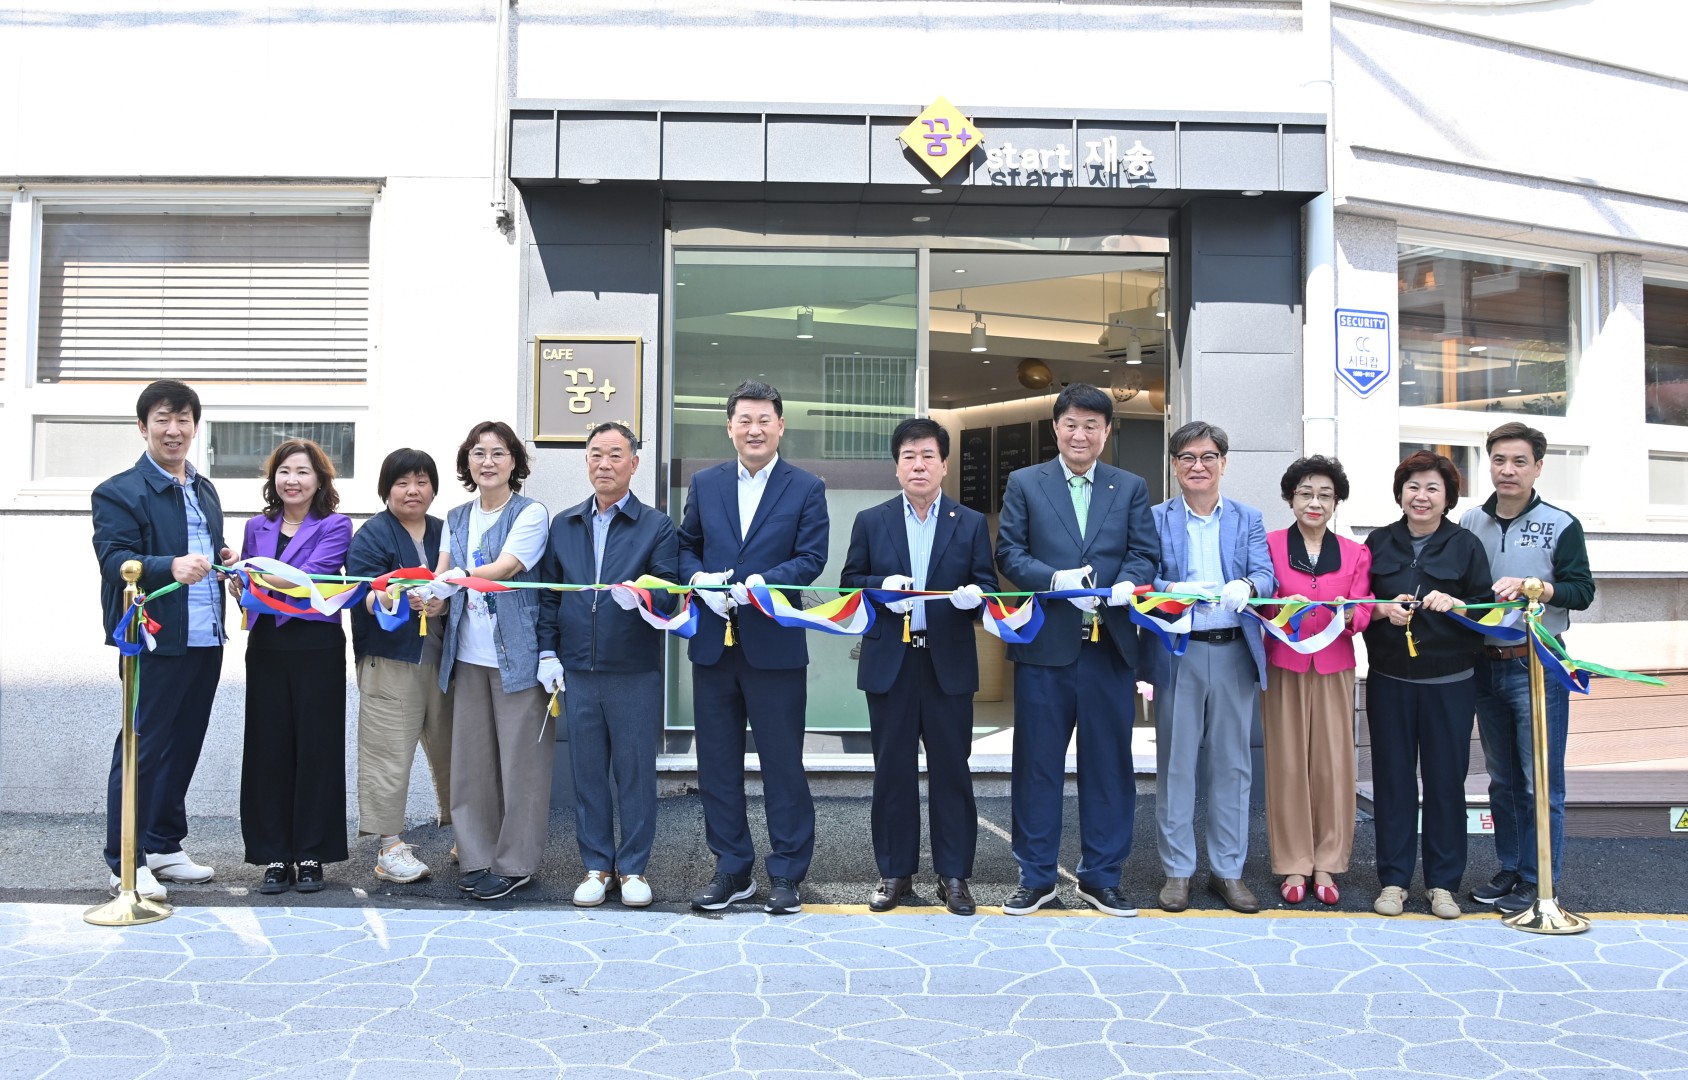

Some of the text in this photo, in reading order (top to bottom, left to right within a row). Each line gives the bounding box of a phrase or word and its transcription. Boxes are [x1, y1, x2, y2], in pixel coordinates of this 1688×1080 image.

[986, 142, 1073, 170] start
[1085, 136, 1155, 176] 재송
[1340, 315, 1386, 329] SECURITY
[543, 348, 574, 360] CAFE
[1348, 355, 1379, 369] 시티캅
[1520, 520, 1555, 535] JOIE
